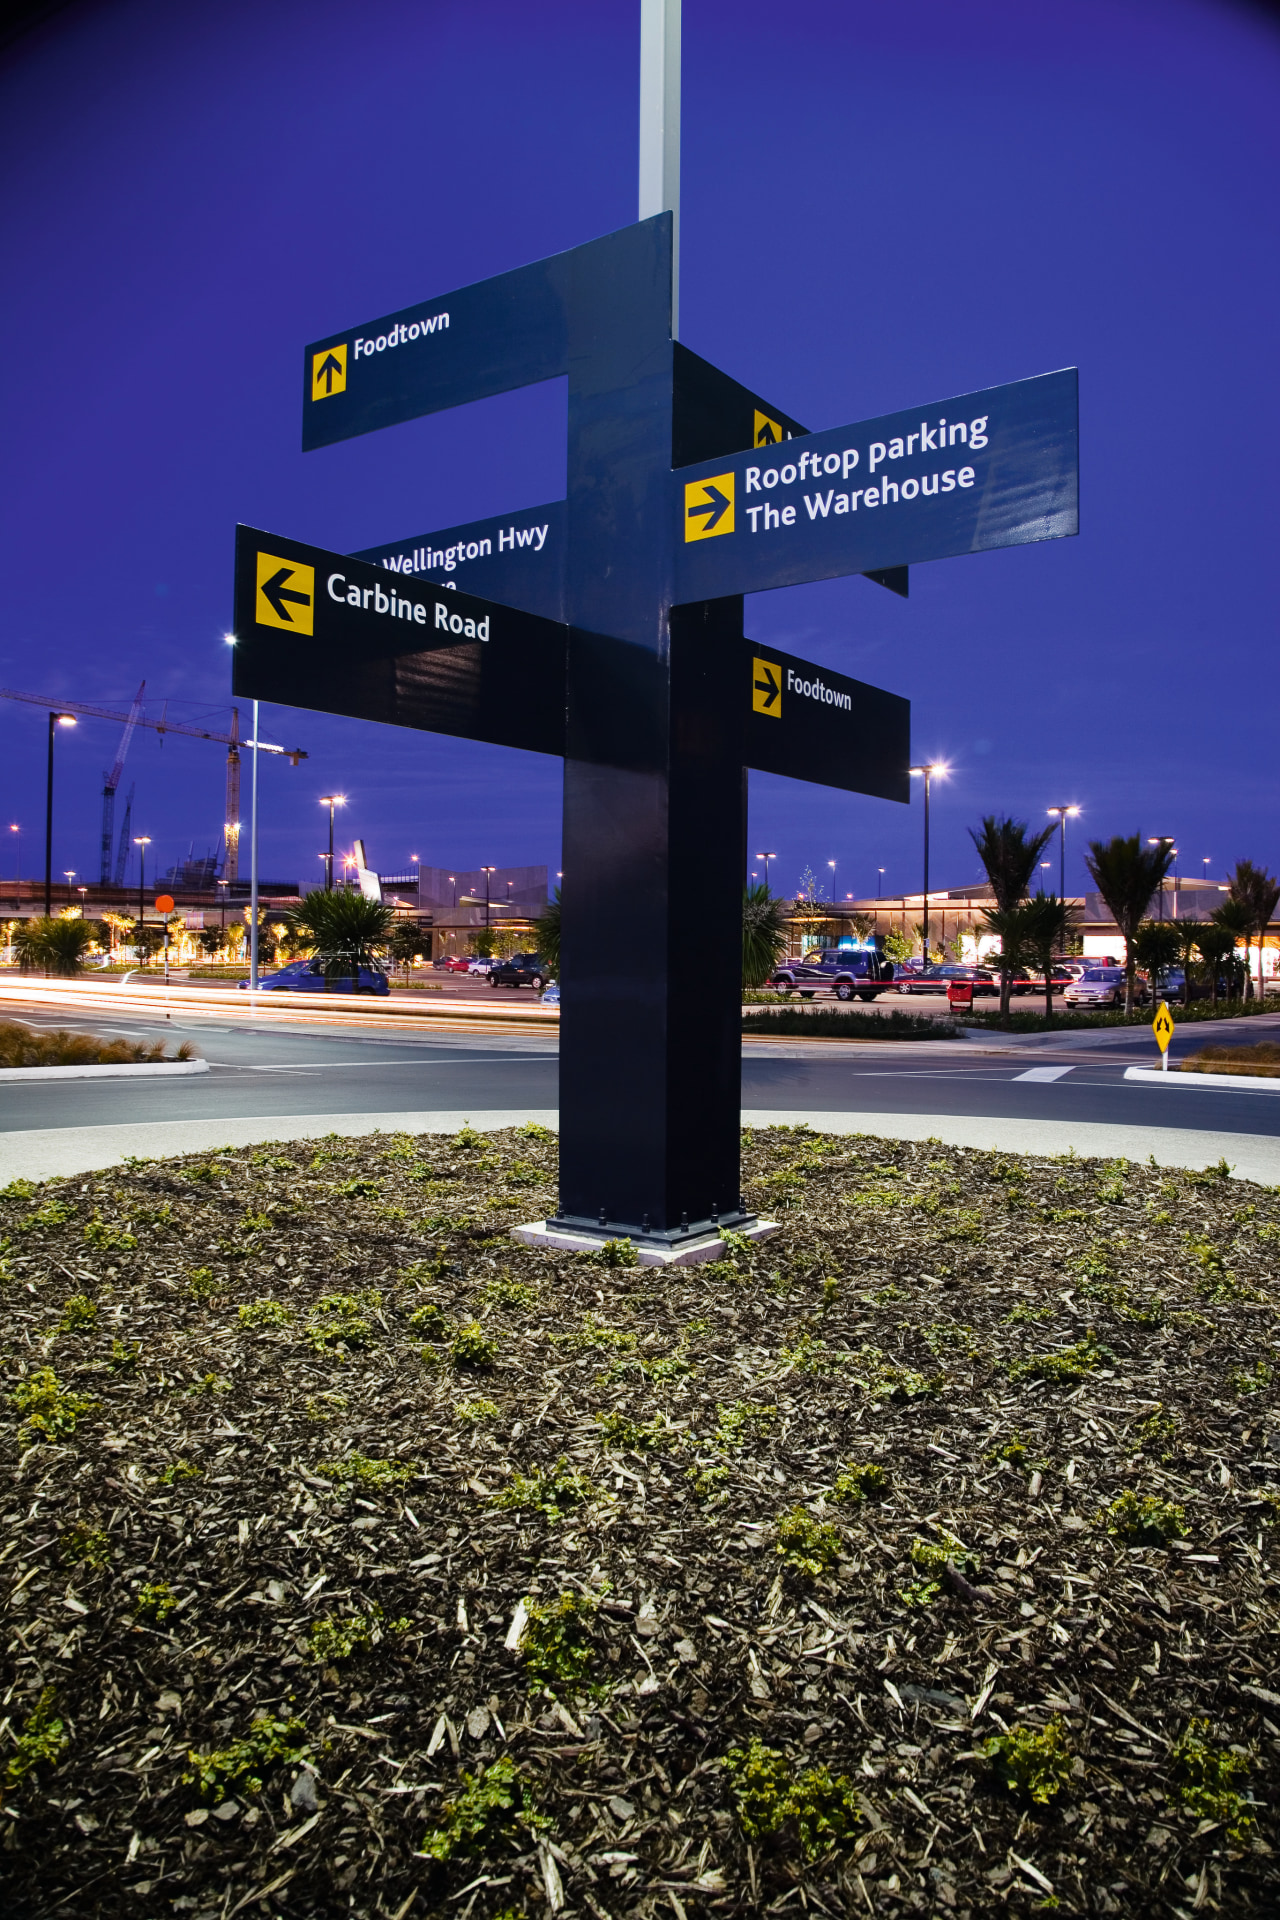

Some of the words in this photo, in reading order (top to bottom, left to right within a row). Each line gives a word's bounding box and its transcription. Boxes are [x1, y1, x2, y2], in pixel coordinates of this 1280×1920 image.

[353, 311, 451, 361] Foodtown
[745, 446, 860, 494] Rooftop
[869, 415, 989, 474] parking
[746, 502, 797, 534] The
[803, 466, 976, 521] Warehouse
[382, 538, 492, 575] Wellington
[498, 524, 549, 552] Hwy
[327, 573, 427, 625] Carbine
[435, 602, 490, 642] Road
[787, 669, 852, 711] Foodtown
